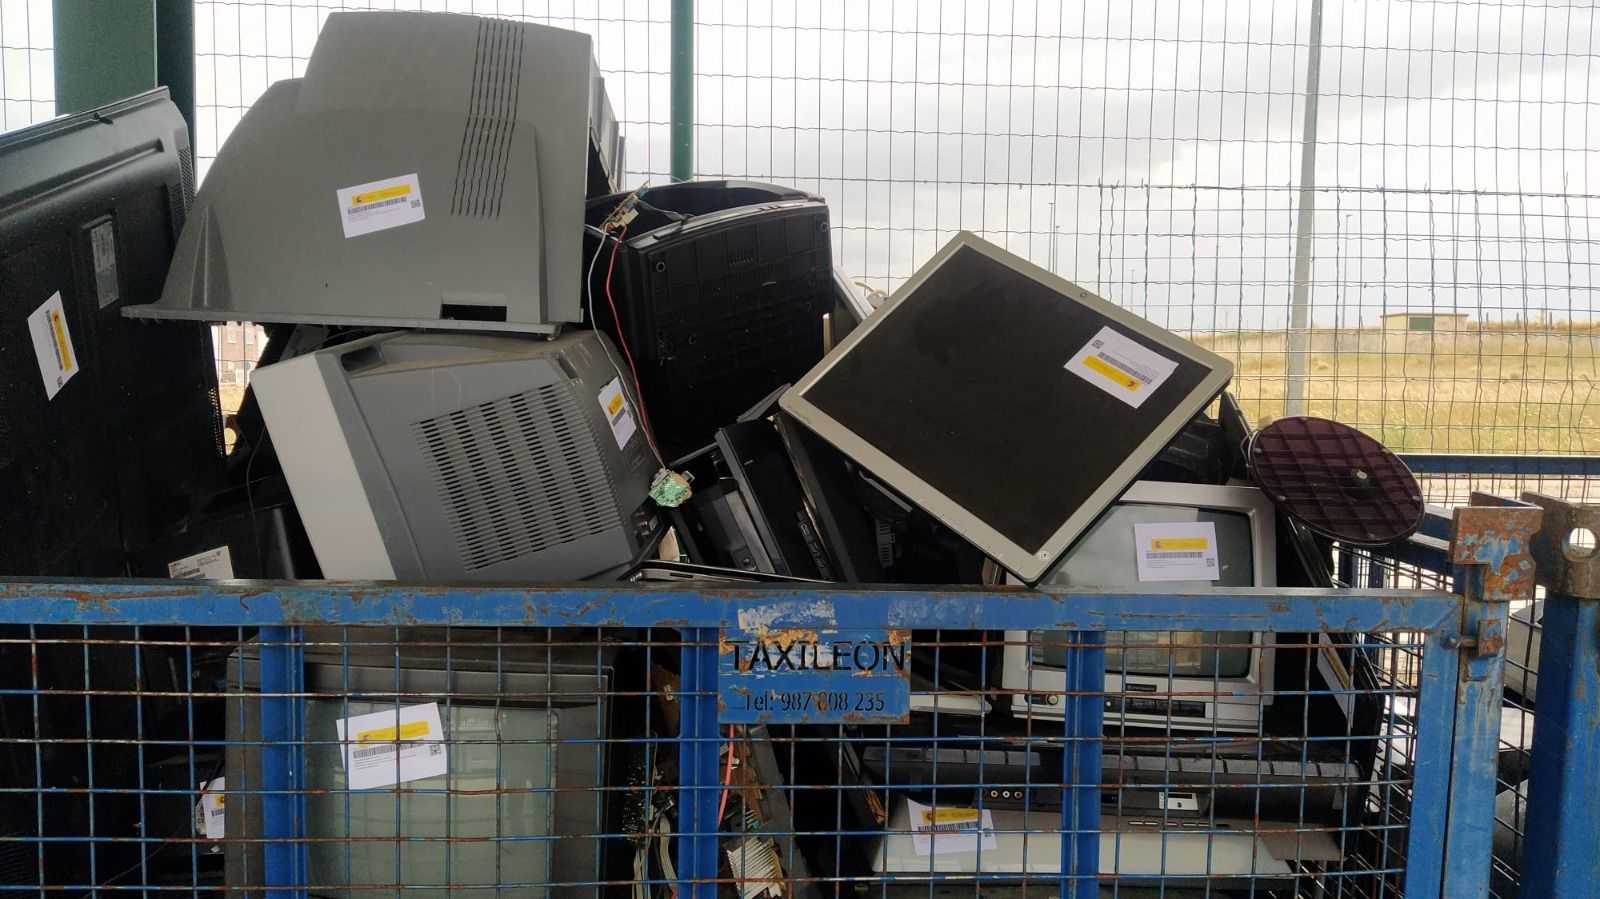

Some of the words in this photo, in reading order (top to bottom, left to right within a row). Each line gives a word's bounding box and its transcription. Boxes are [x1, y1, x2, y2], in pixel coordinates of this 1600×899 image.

[725, 641, 906, 671] TAXILEON
[780, 691, 814, 712] 987
[854, 691, 885, 712] 235
